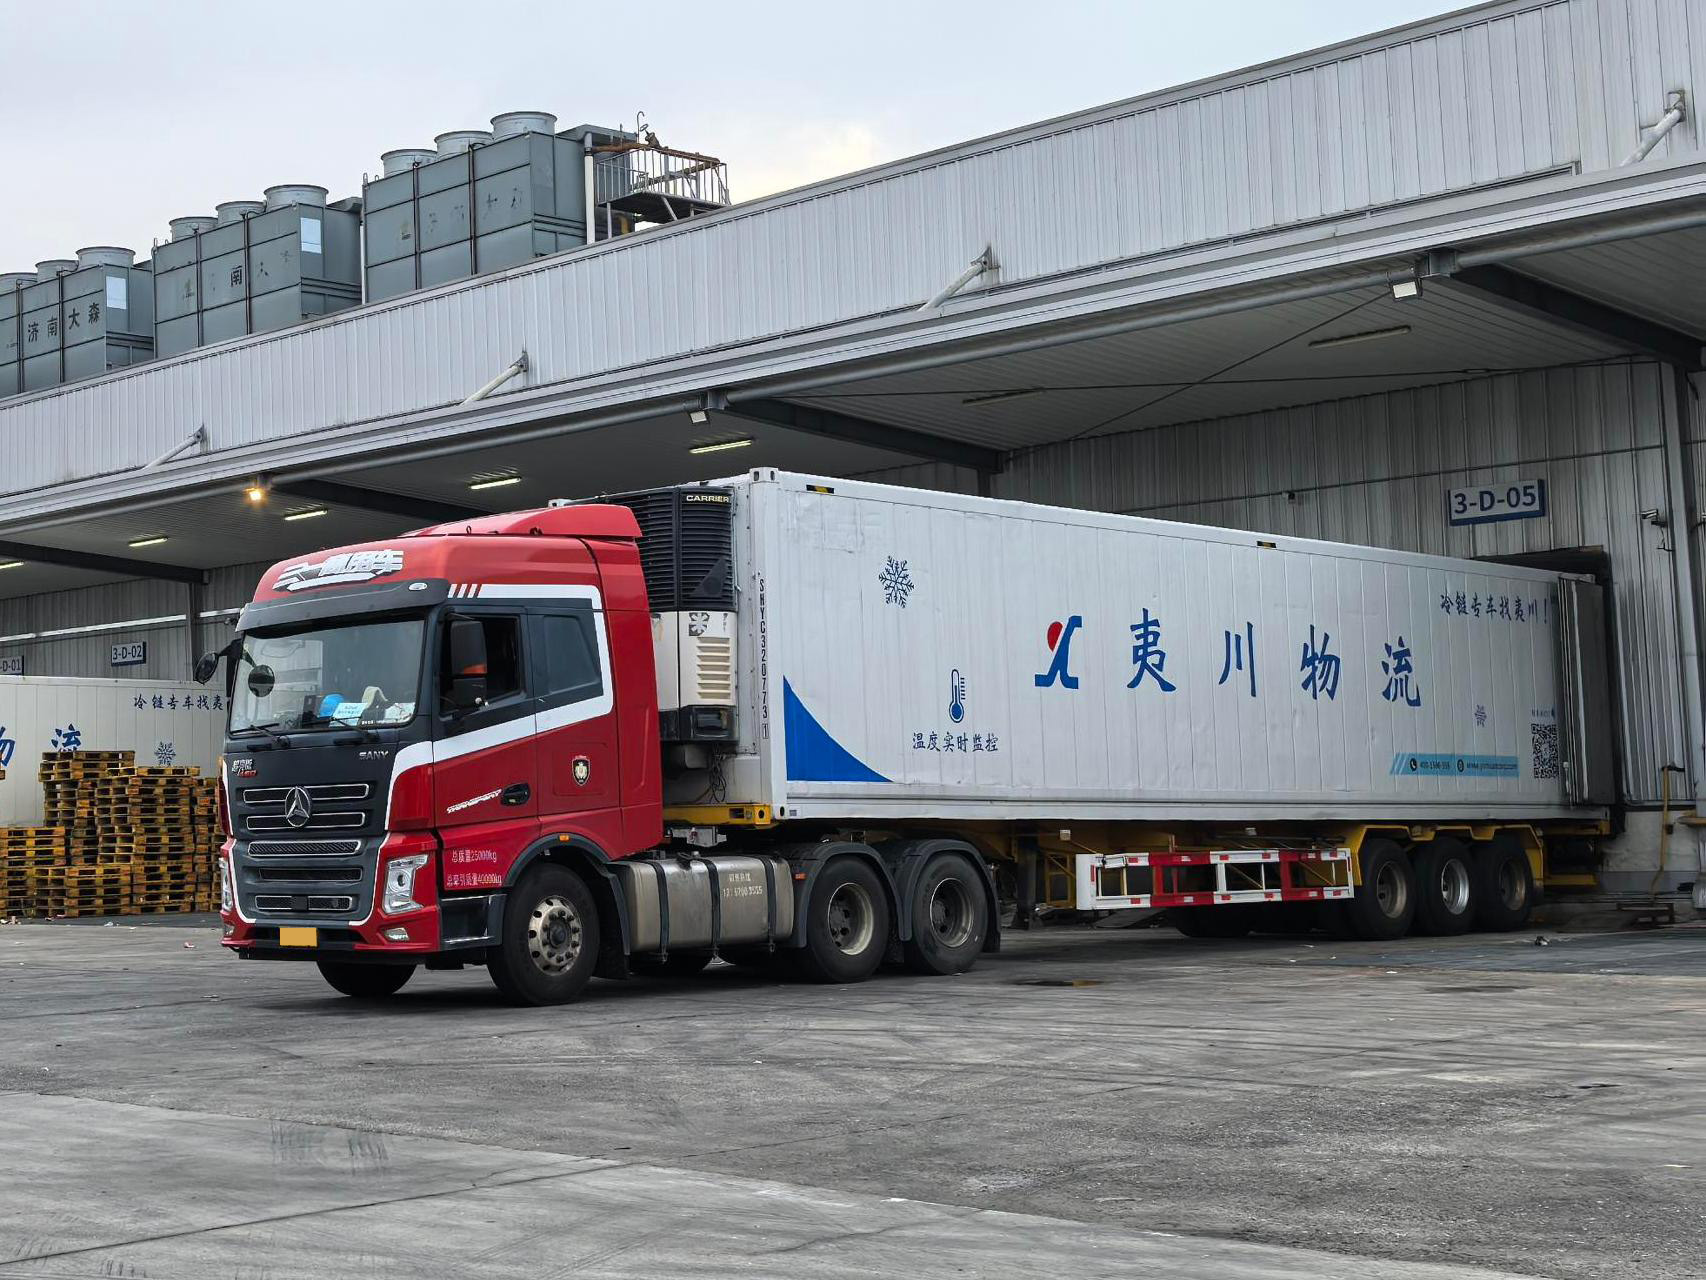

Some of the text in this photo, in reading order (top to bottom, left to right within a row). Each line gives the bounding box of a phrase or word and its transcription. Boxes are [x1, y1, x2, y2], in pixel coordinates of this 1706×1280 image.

[686, 495, 729, 503] CARRIER
[1453, 485, 1537, 514] 3-D-05
[112, 645, 143, 660] 3-D-02
[1127, 608, 1422, 708] 夷川物流
[912, 730, 999, 753] 温度实时监控
[359, 751, 389, 761] SANY
